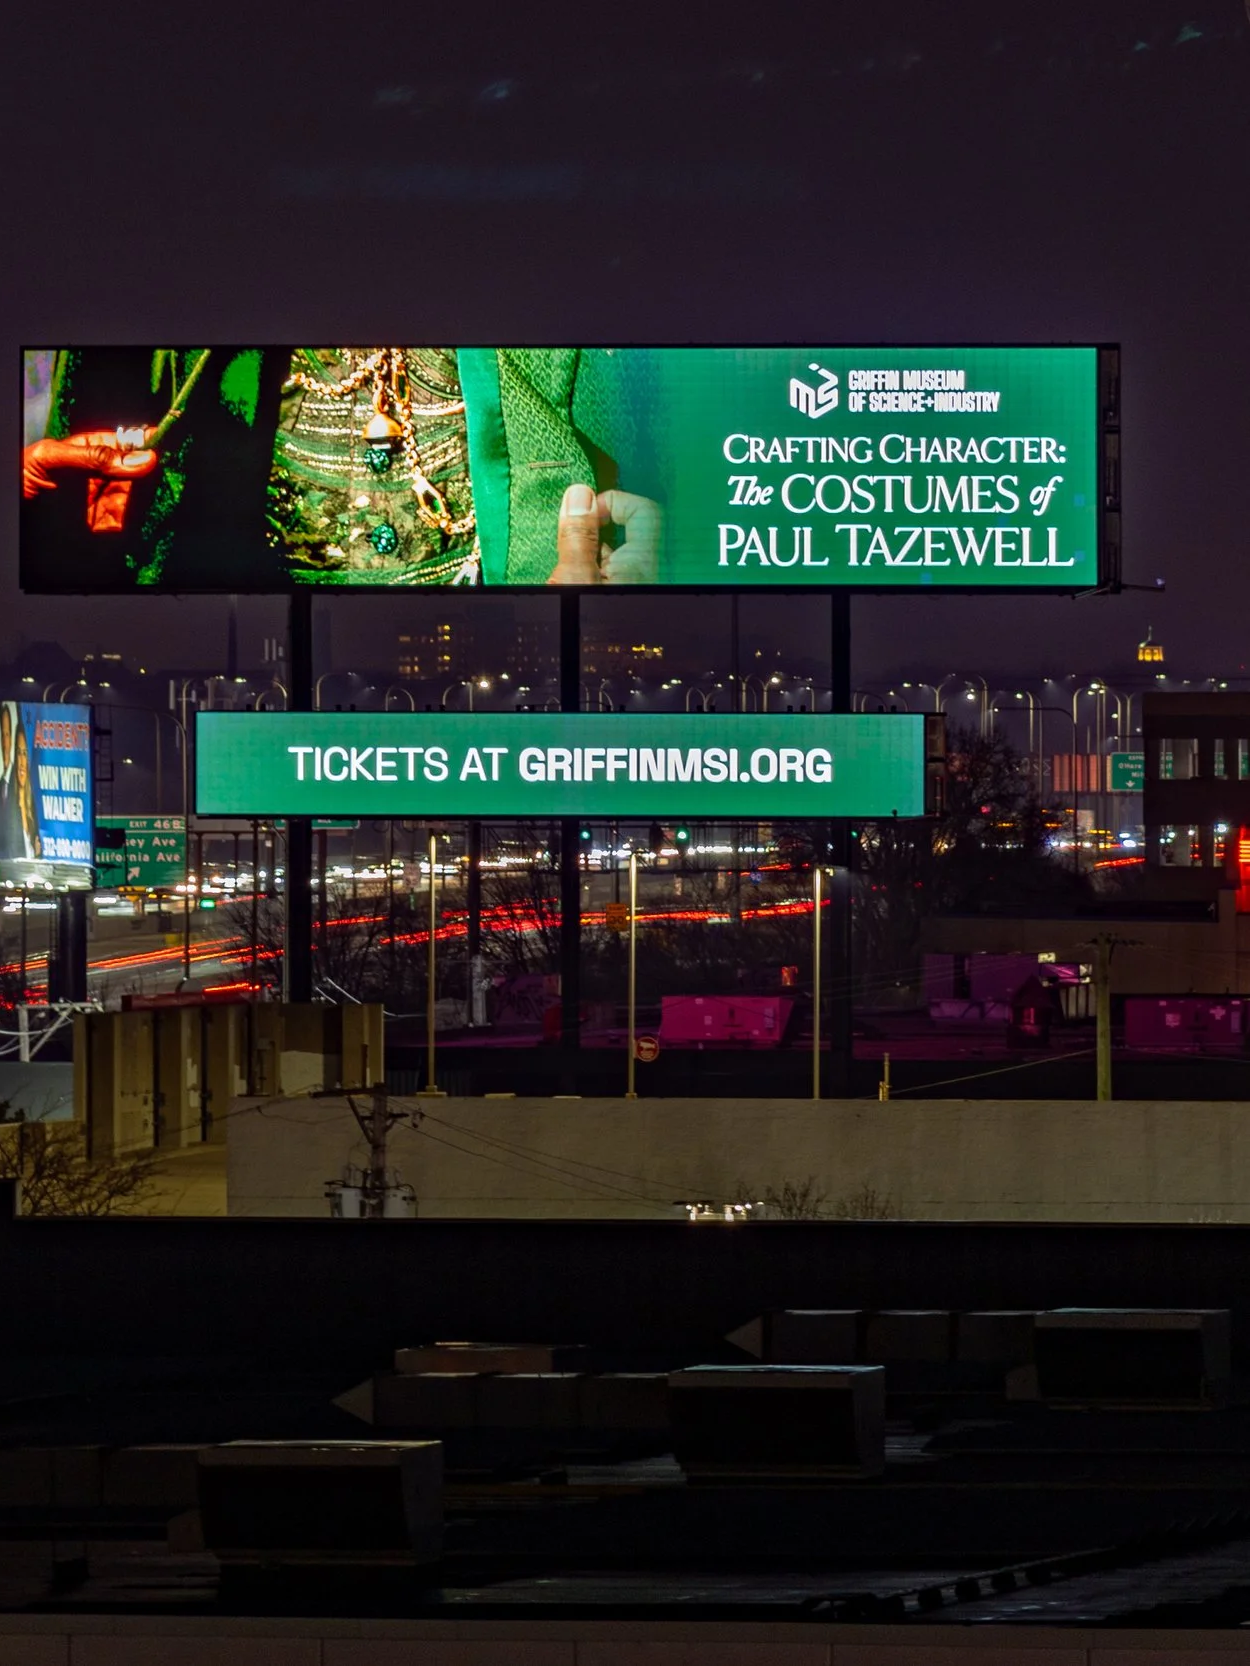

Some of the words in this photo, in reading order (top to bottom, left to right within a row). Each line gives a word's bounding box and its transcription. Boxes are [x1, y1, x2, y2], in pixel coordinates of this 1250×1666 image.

[849, 370, 900, 390] GRIFFIN
[903, 370, 965, 390] MUSEUM
[849, 392, 866, 412] OF
[869, 392, 1000, 412] SCIENCE+INDUSTRY
[723, 434, 872, 463] CRAFTING
[880, 434, 1066, 463] CHARACTER:
[728, 475, 773, 505] The
[782, 474, 1019, 513] COSTUMES
[1030, 476, 1063, 515] of
[718, 525, 829, 566] PAUL
[835, 525, 1074, 566] TAZEWELL
[288, 747, 448, 782] TICKETS
[460, 747, 508, 782] AT
[519, 747, 832, 782] GRIFFINMSI.ORG
[38, 765, 59, 791] WIN
[60, 766, 87, 793] WITH
[42, 795, 84, 823] WALNER
[152, 837, 176, 847] Ave
[156, 852, 181, 862] Ave
